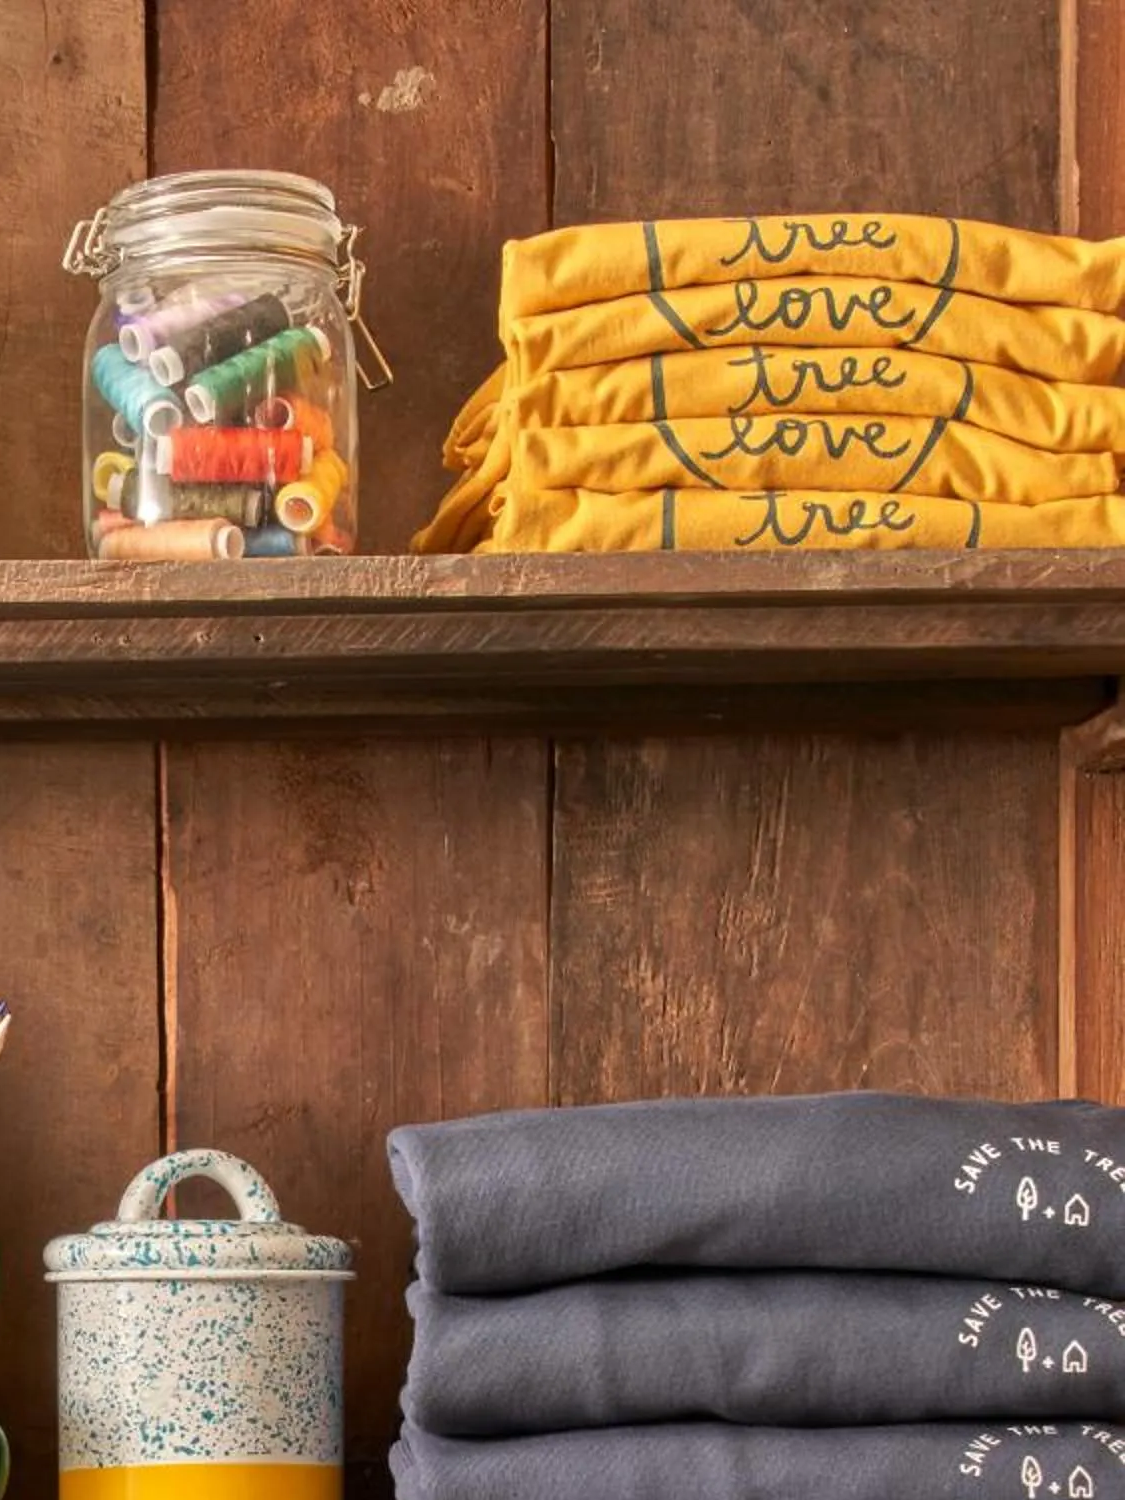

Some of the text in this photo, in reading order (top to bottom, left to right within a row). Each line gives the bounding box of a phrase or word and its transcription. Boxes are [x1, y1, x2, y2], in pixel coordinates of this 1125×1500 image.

[720, 218, 897, 265] tree
[706, 280, 917, 337] love
[727, 345, 907, 415] tree
[701, 416, 910, 460] love
[735, 492, 917, 546] tree
[954, 1143, 1002, 1194] SAVE
[1010, 1136, 1062, 1155] THE
[958, 1293, 1003, 1348] SAVE
[1009, 1286, 1061, 1300] THE
[959, 1433, 1003, 1477] SAVE
[1006, 1424, 1059, 1437] THE
